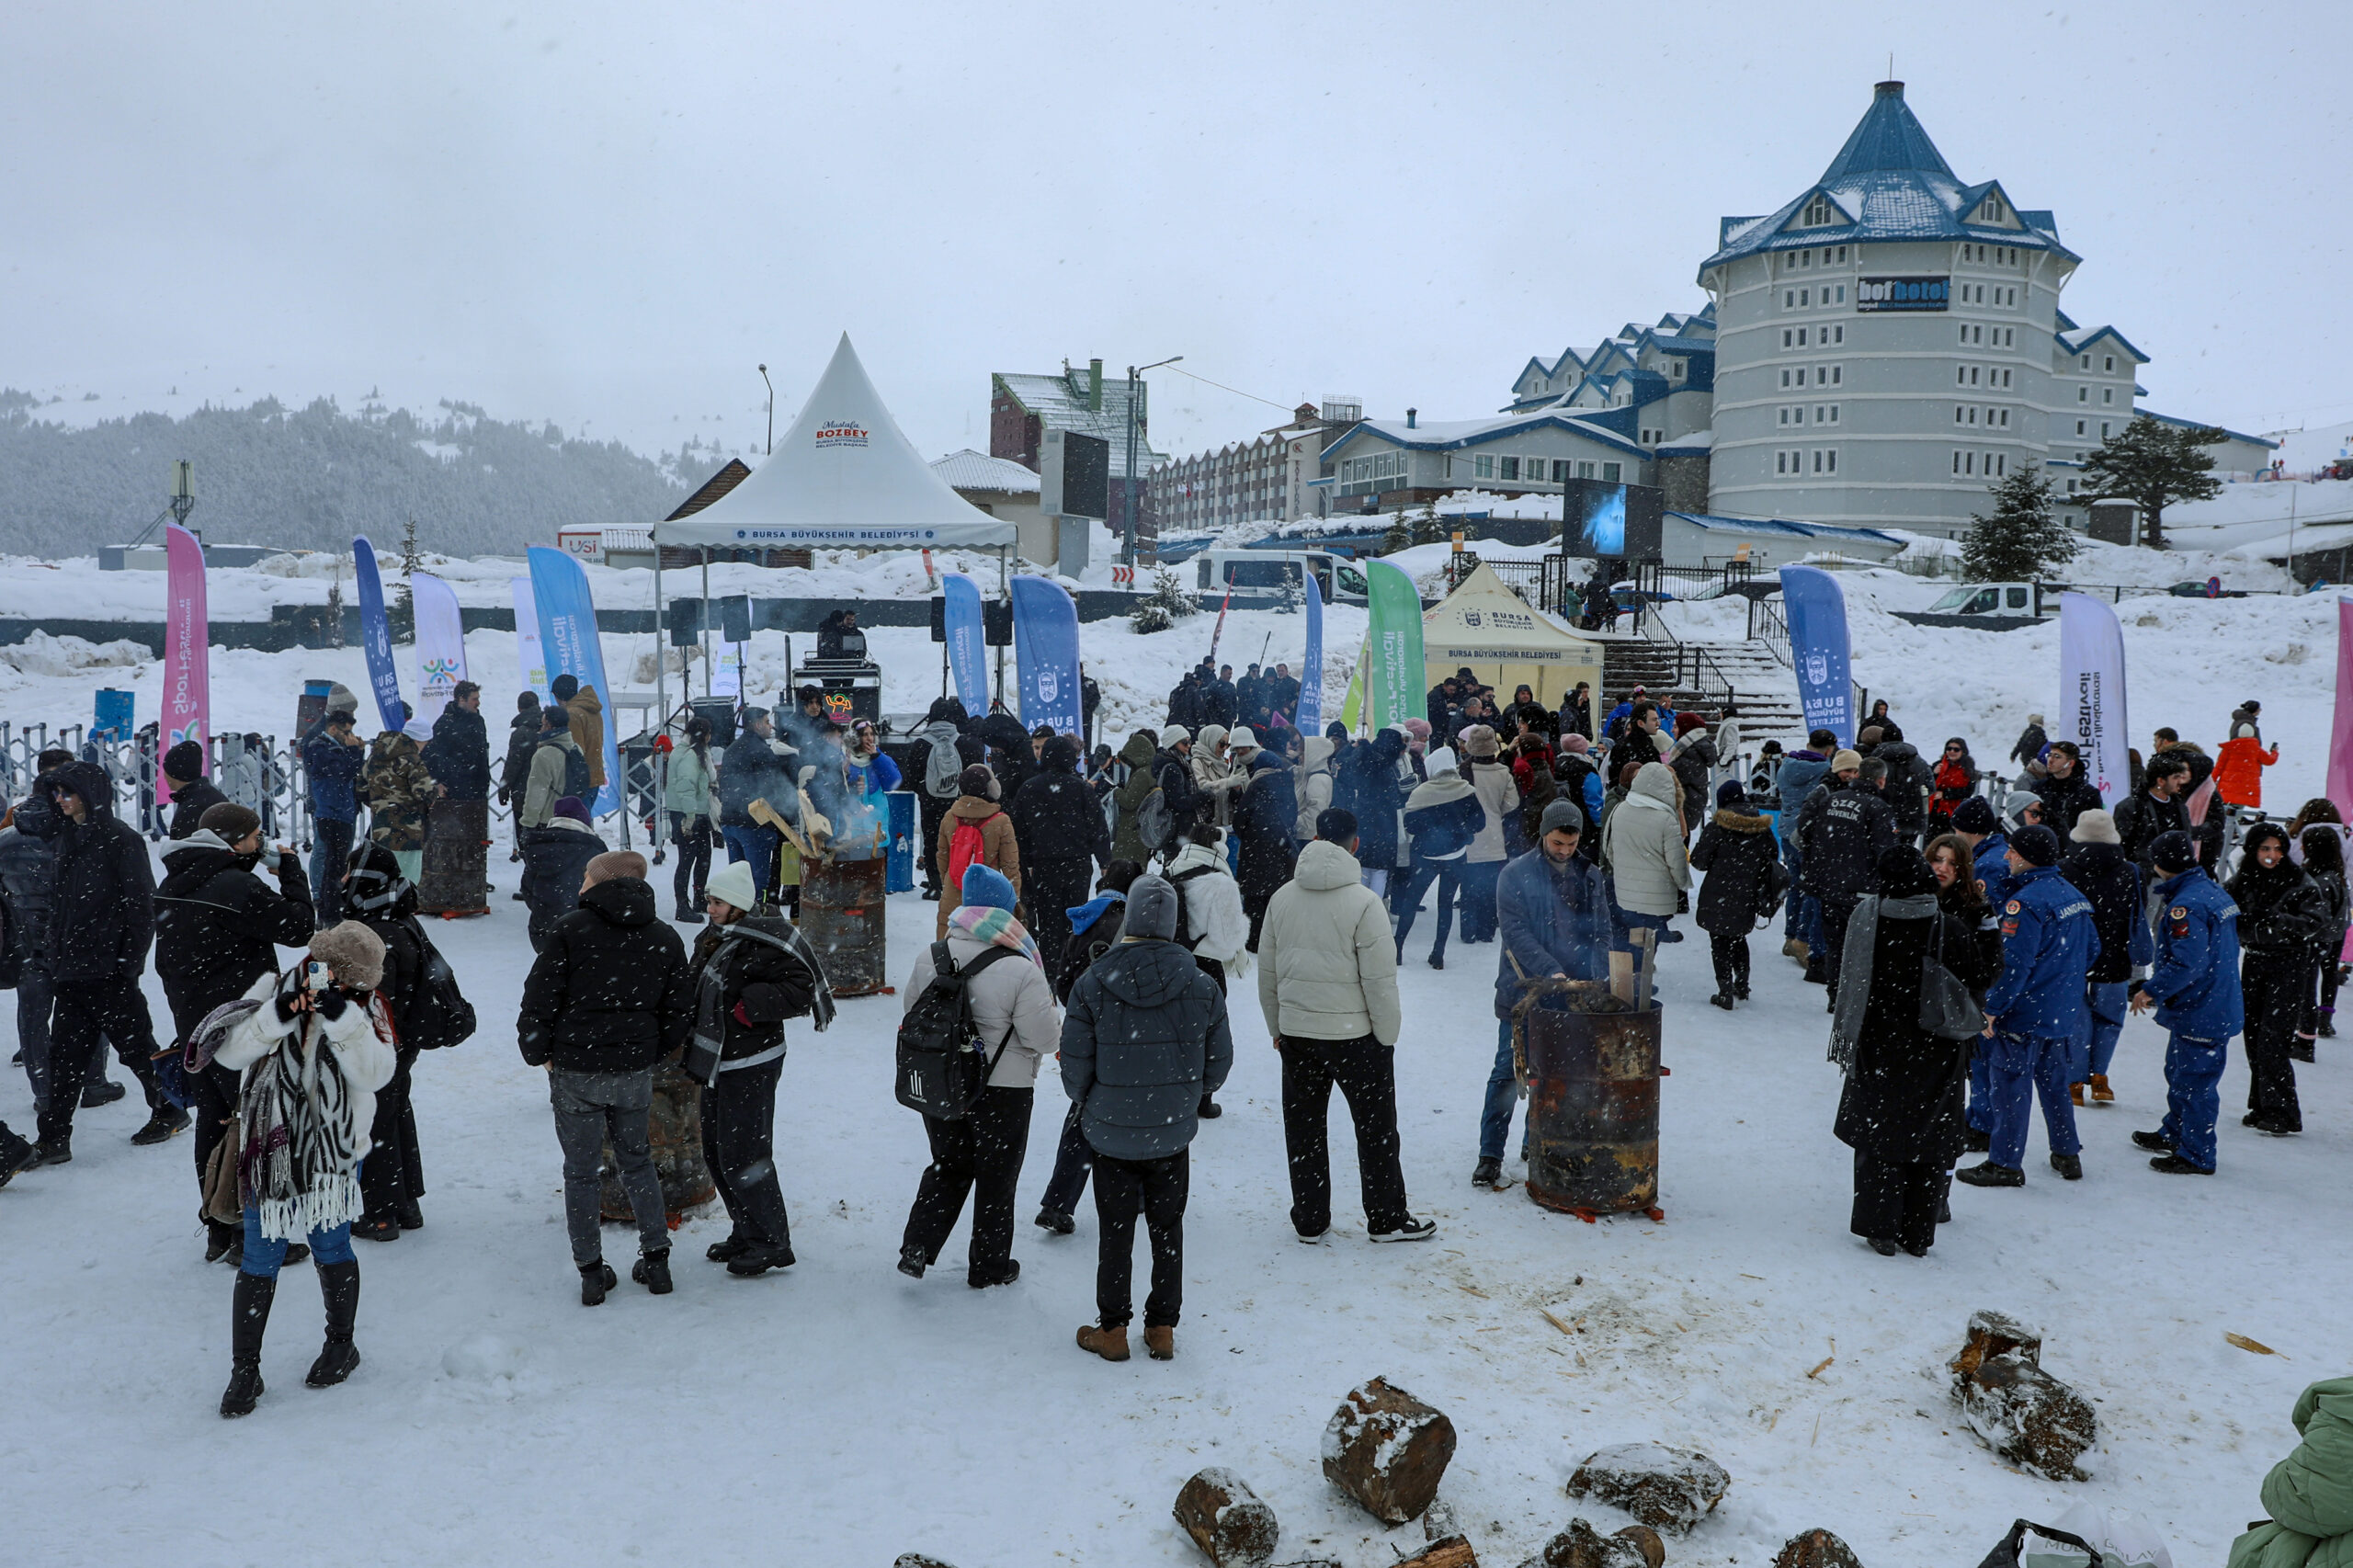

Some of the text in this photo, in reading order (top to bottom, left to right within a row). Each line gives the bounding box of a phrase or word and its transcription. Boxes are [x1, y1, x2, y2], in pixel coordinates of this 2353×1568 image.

[823, 420, 859, 429] Mustafa
[816, 428, 868, 438] BOZBEY
[791, 530, 855, 540] BÜYÜKŞEHİR
[860, 530, 919, 540] BELEDİYESİ
[1493, 611, 1531, 621] BURSA
[1494, 619, 1533, 627] BÜYÜKŞEHİR
[1449, 649, 1562, 660] BURSA BÜYÜKŞEHİR BELEDİYESİ
[1831, 798, 1862, 813] ÖZEL
